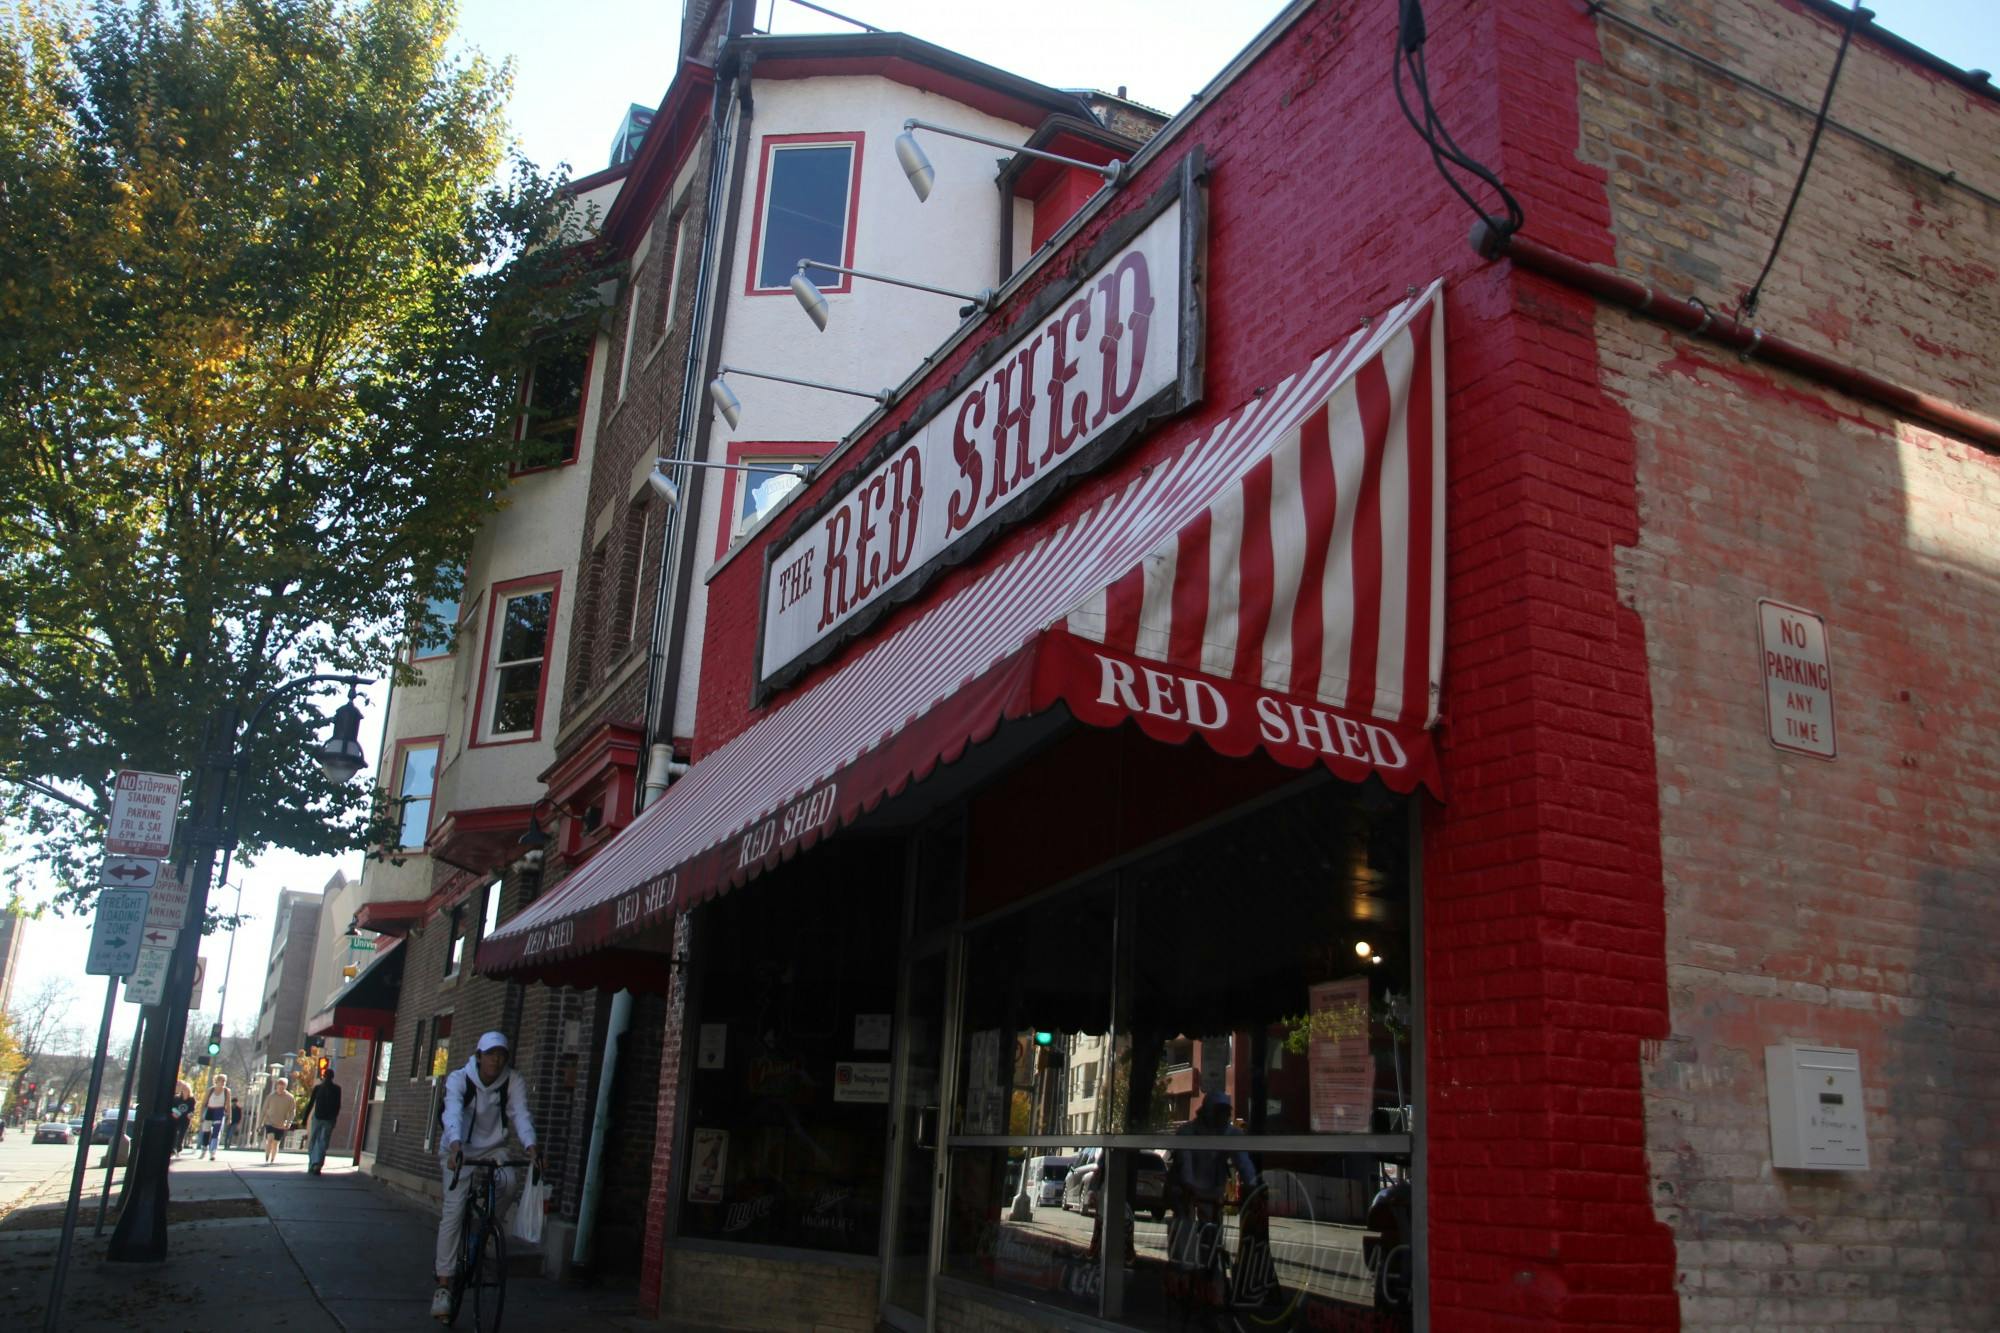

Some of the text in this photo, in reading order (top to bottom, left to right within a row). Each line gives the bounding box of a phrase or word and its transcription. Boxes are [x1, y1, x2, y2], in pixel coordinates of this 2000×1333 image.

[779, 249, 1155, 633] THE RED SHED
[1780, 617, 1807, 649] NO
[1767, 651, 1828, 690] PARKING
[1786, 691, 1813, 713] ANY
[1094, 653, 1407, 769] RED SHED
[1785, 717, 1819, 743] TIME
[120, 775, 177, 795] NO STOPPING
[128, 791, 166, 805] STANDING
[127, 807, 162, 819] PARKING
[737, 783, 837, 869] RED SHED
[118, 830, 135, 839] 6PM
[145, 833, 162, 842] 6AM
[156, 880, 189, 893] OPPING
[103, 897, 142, 909] FREIGHT
[152, 890, 187, 904] ANDING
[616, 873, 677, 929] RED SHED
[102, 910, 140, 922] LOADING
[148, 906, 181, 919] ARKING
[106, 923, 131, 935] ZONE
[524, 919, 574, 956] RED SHED
[354, 937, 377, 950] Univer
